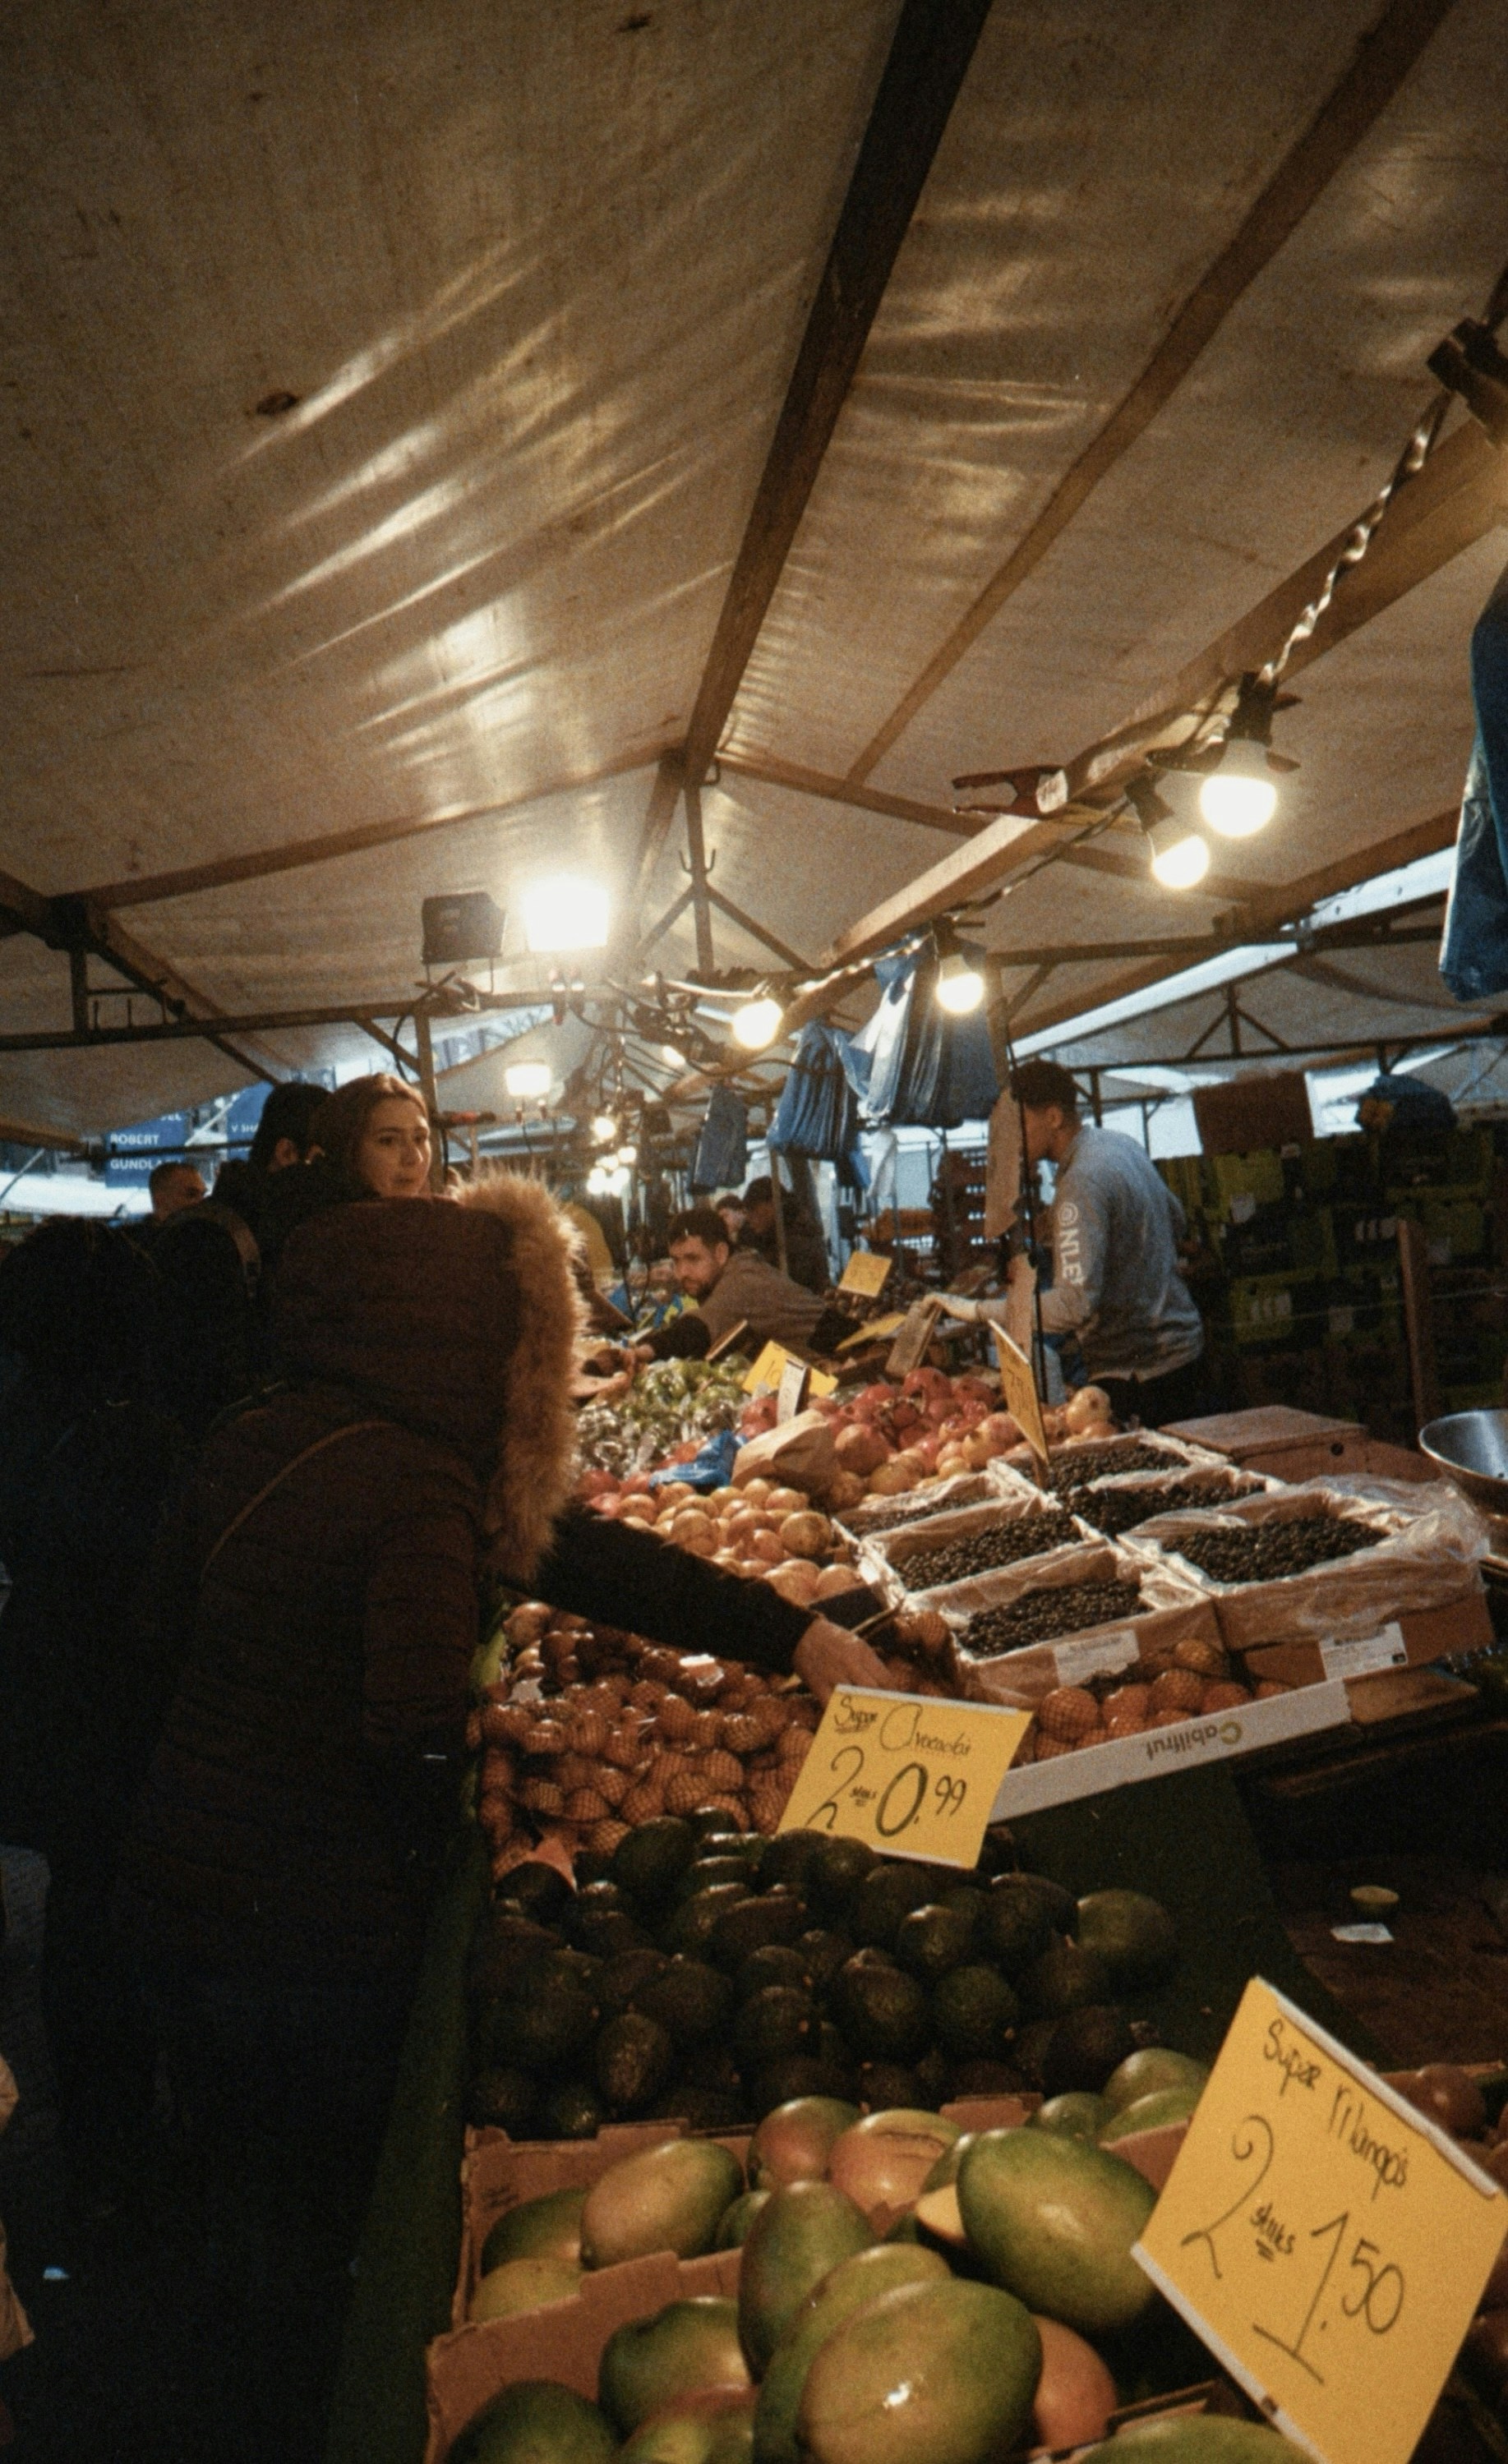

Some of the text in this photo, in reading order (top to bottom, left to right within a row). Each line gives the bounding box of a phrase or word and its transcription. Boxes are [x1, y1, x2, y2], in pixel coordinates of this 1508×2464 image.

[110, 1134, 159, 1145] ROBERT
[805, 1745, 865, 1830] 2
[1180, 2114, 1275, 2280] 2
[1252, 2210, 1405, 2387] 1.50
